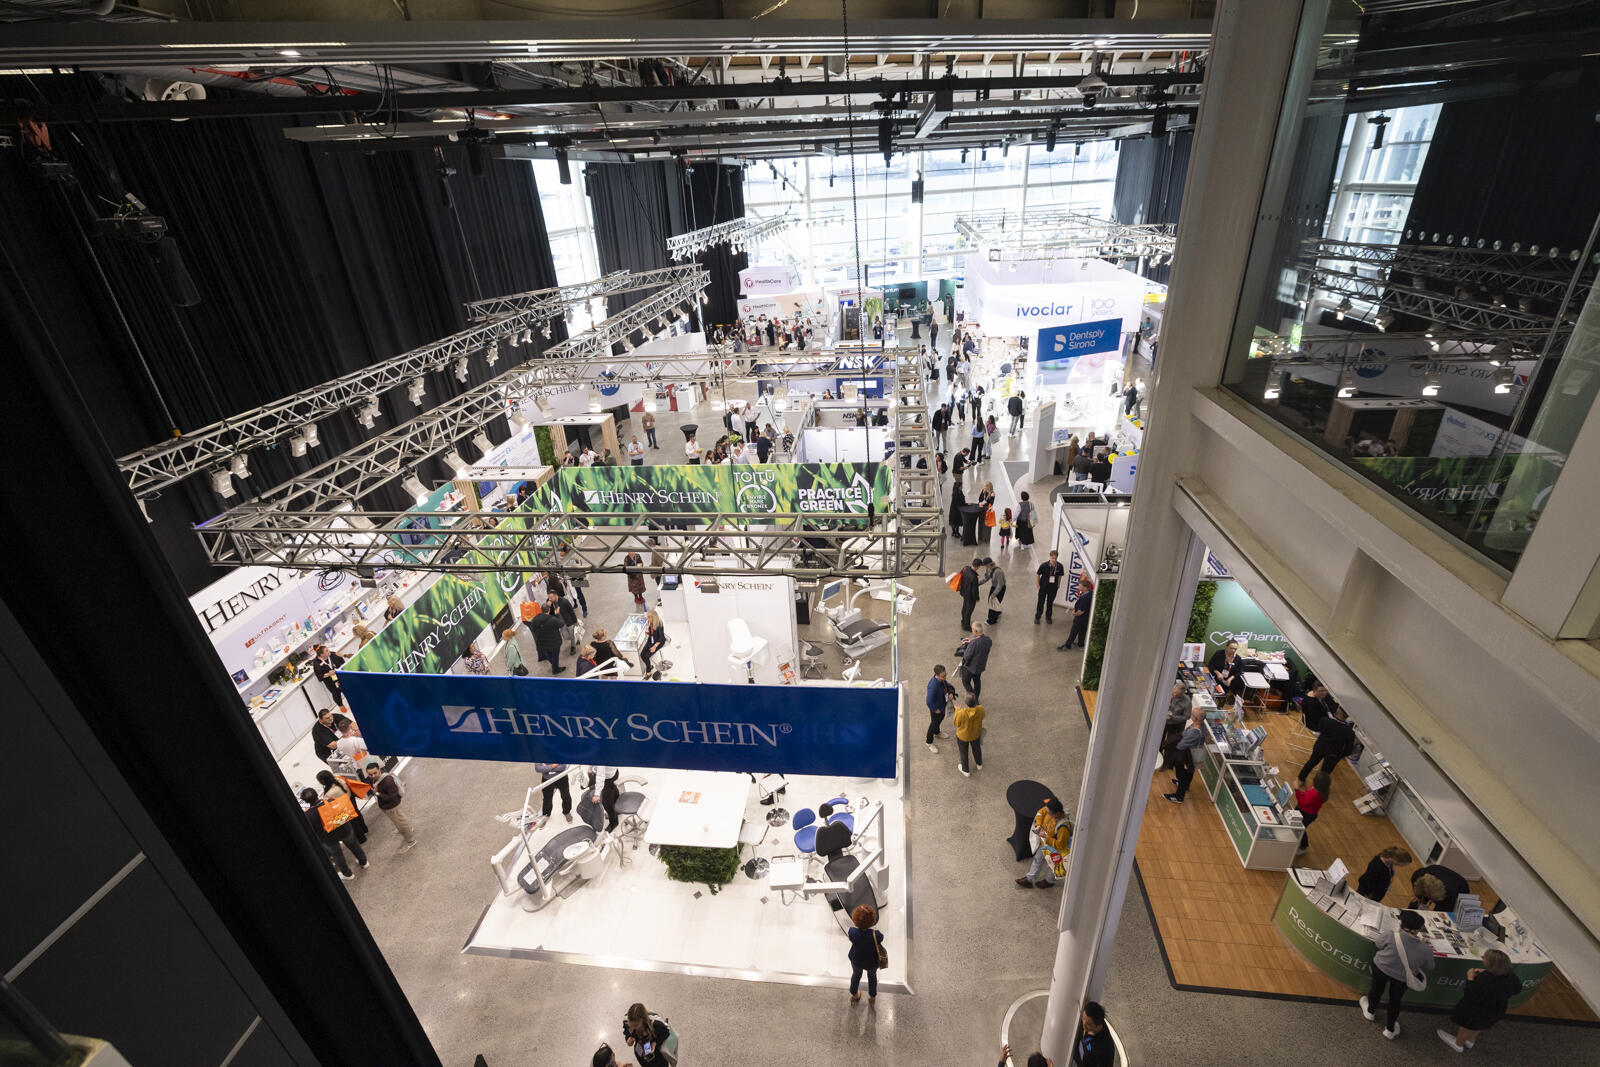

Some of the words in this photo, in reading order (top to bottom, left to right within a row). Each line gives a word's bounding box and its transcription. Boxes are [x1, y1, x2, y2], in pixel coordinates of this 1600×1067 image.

[1016, 302, 1073, 317] ivoclar
[1069, 328, 1105, 341] Dentsply
[1068, 340, 1097, 350] Sirona
[838, 356, 877, 370] NSK
[734, 470, 775, 483] TOITŪ
[599, 491, 655, 504] HENRY
[658, 489, 720, 504] SCHEIN
[798, 487, 863, 500] PRACTICE
[799, 500, 844, 512] GREEN
[737, 581, 772, 590] SCHEIN
[199, 567, 283, 635] HENRY
[440, 582, 487, 636] SCHEIN
[484, 706, 620, 740] HENRY
